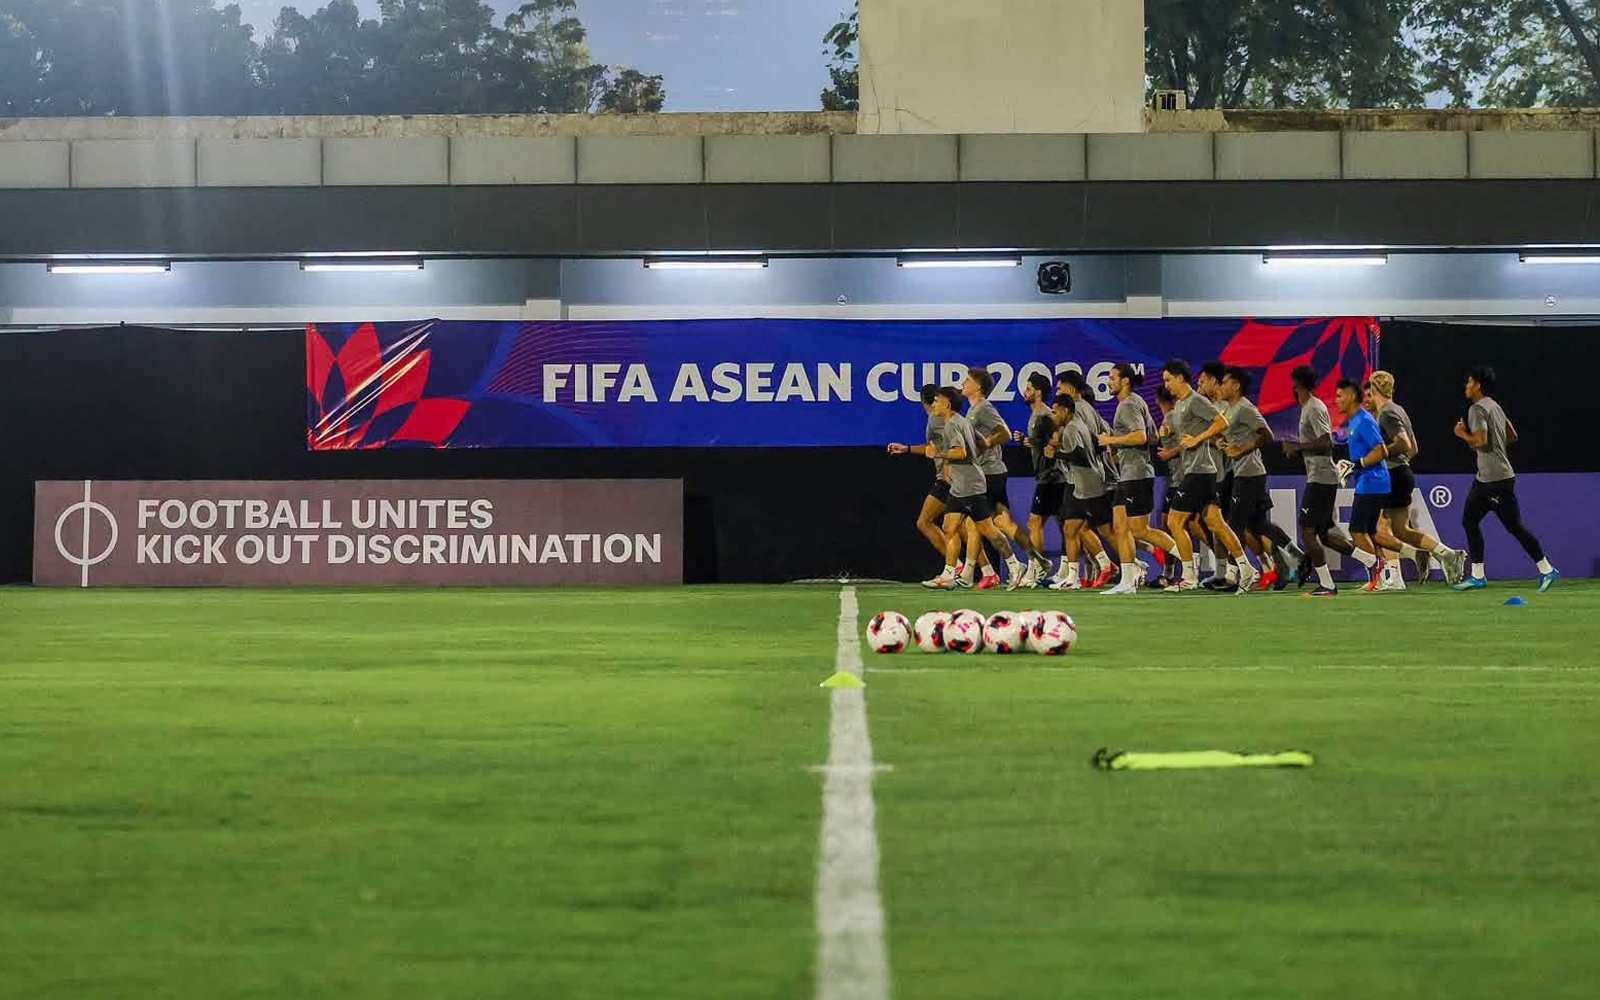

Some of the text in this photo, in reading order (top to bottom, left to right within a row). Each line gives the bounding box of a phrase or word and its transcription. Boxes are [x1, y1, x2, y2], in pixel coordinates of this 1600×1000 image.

[542, 363, 658, 403] FIFA
[669, 362, 852, 403] ASEAN
[137, 499, 493, 529] FOOTBALL UNITES
[136, 533, 662, 565] KICK OUT DISCRIMINATION
